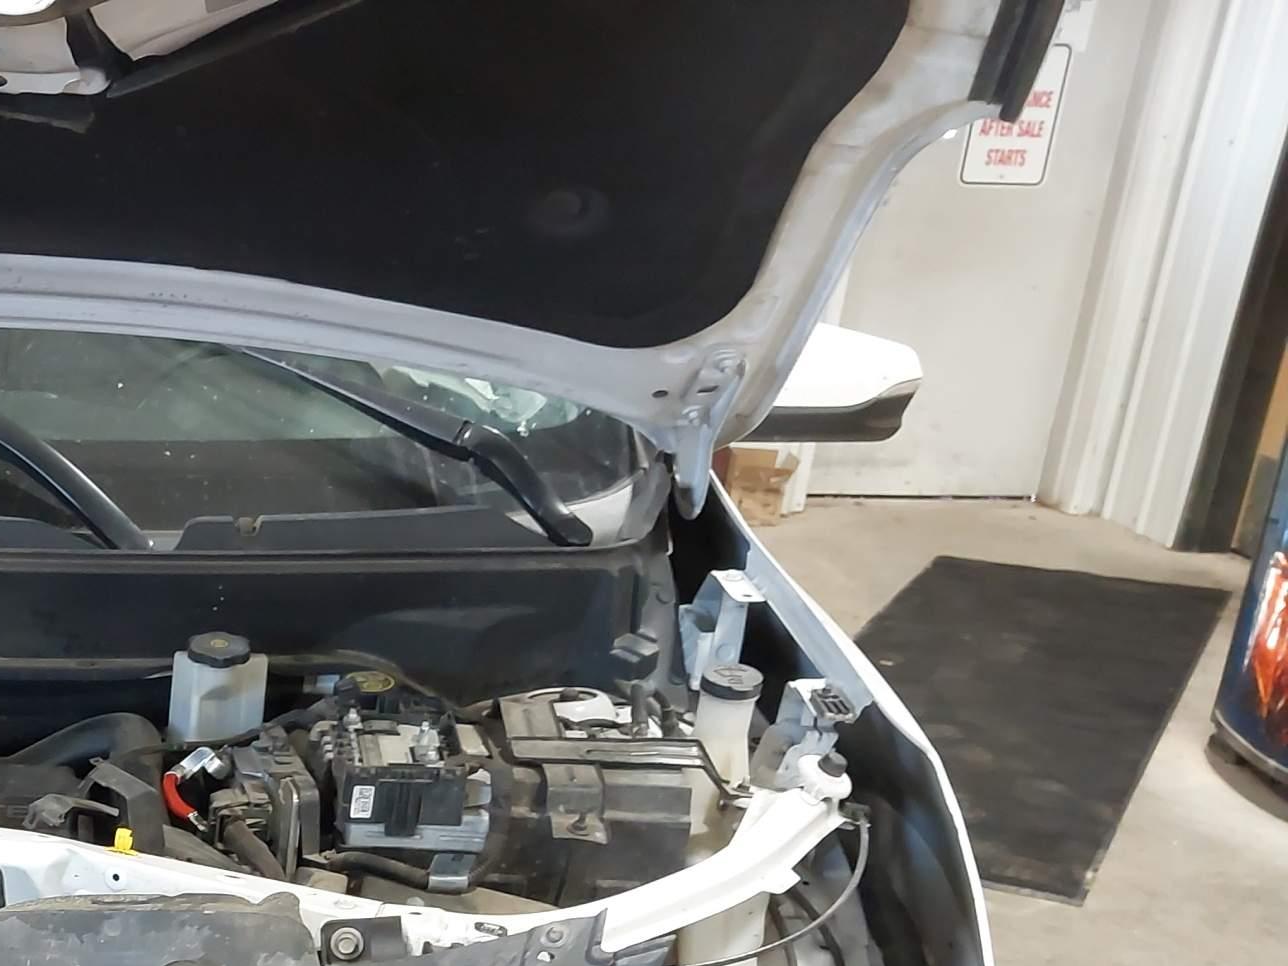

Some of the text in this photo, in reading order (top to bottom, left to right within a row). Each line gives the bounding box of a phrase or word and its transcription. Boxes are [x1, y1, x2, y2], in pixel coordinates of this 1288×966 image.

[979, 118, 1045, 138] AFTER SALE
[984, 148, 1027, 167] STARTS
